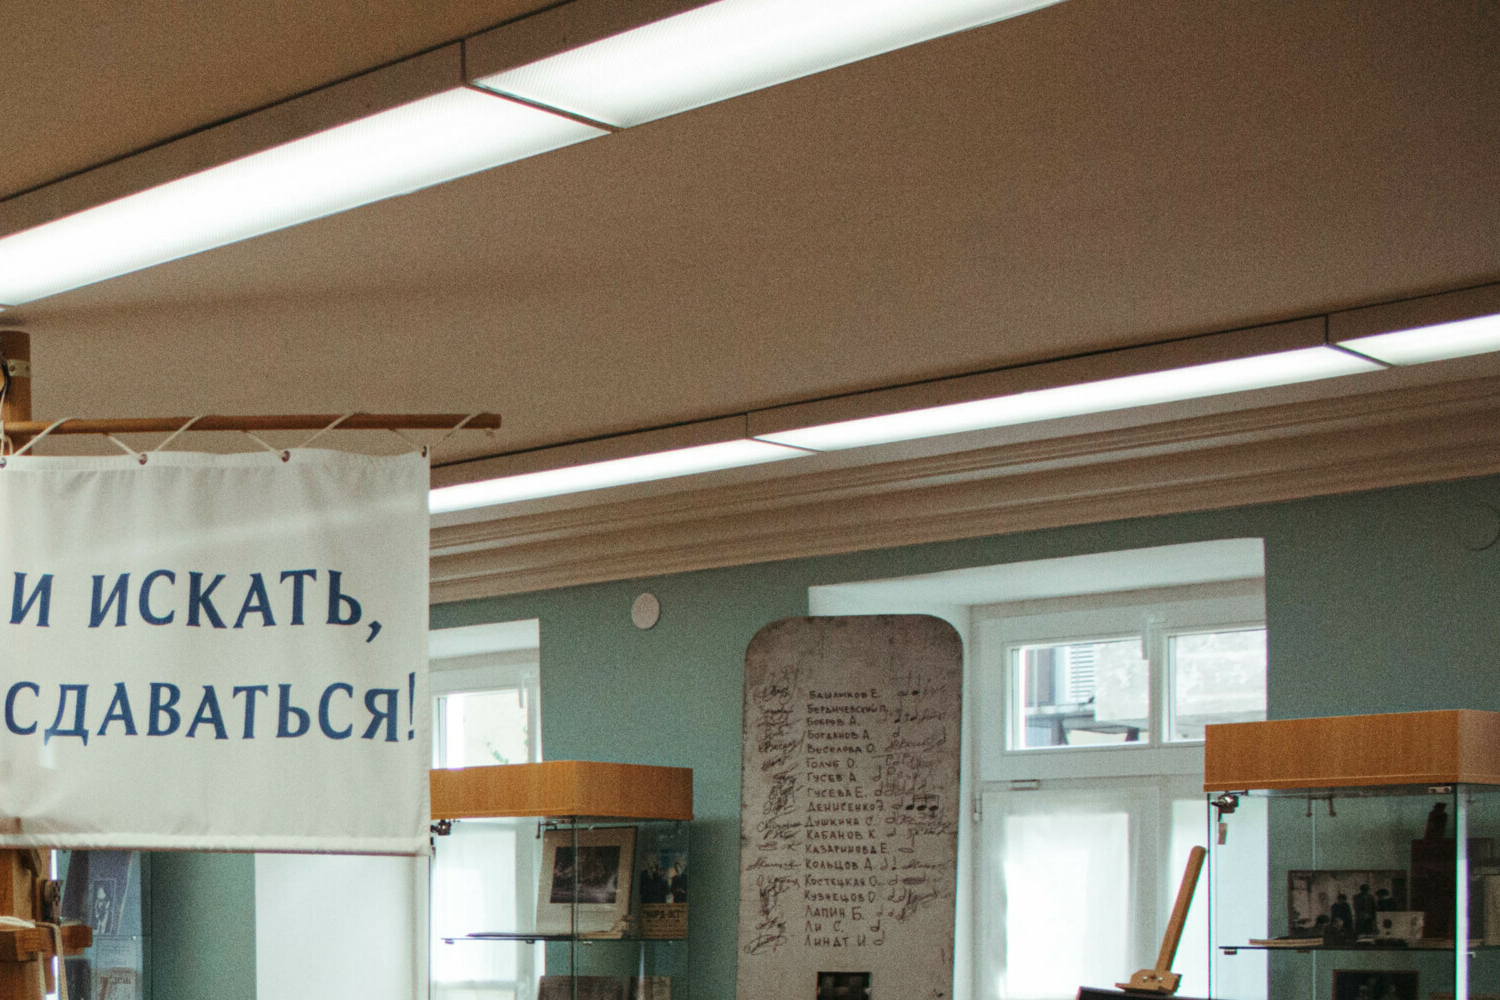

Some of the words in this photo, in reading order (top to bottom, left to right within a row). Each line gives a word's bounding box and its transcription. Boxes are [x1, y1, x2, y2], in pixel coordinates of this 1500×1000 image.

[9, 571, 53, 629] И
[88, 568, 383, 644] ИСКАТЬ,
[3, 671, 419, 748] СДАВАТЬСЯ!
